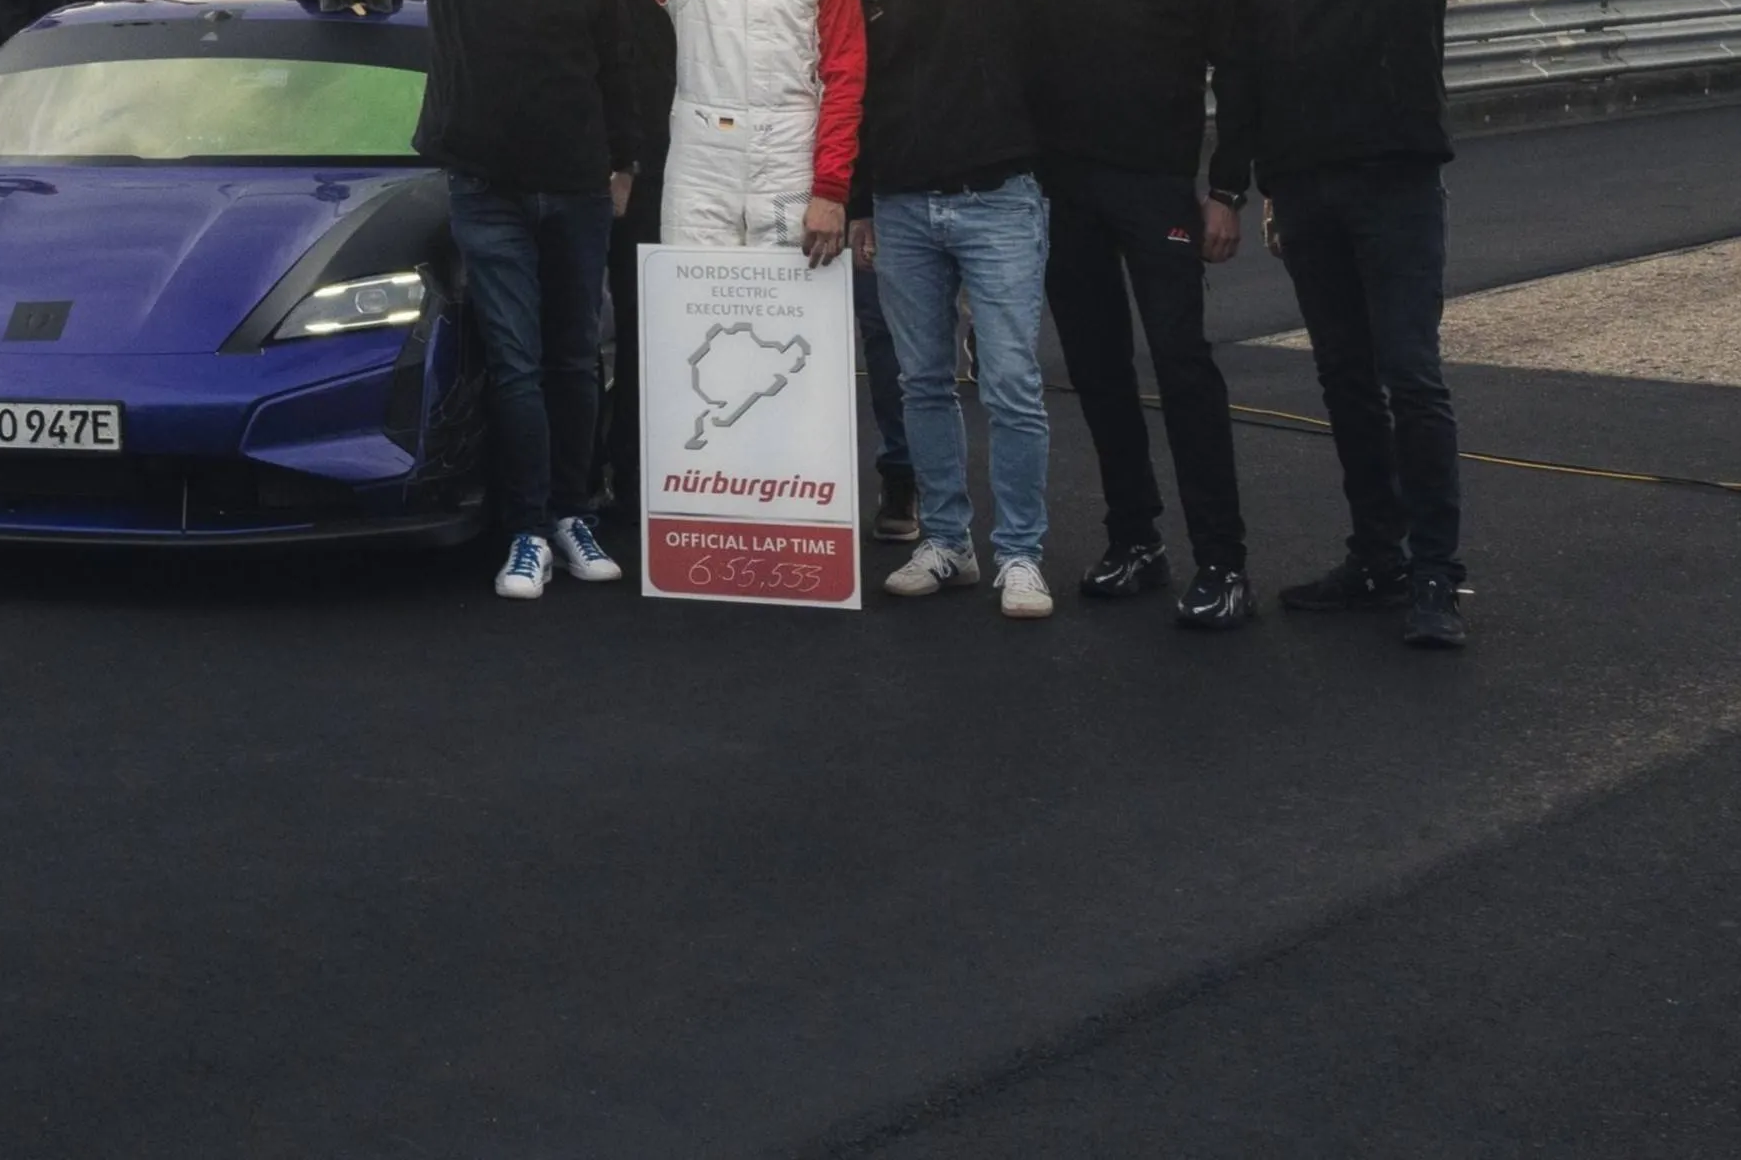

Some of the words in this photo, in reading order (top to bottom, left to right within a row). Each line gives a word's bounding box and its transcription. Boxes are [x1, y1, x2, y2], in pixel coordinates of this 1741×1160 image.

[676, 264, 814, 282] NORDSCHLEIFE
[711, 286, 779, 299] ELECTRIC
[686, 302, 765, 317] EXECUTIVE
[766, 305, 805, 318] CARS
[25, 410, 114, 444] 947E
[663, 470, 836, 505] nürburgring
[665, 531, 749, 551] OFFICIAL
[752, 535, 787, 552] LAP
[790, 538, 837, 556] TIME
